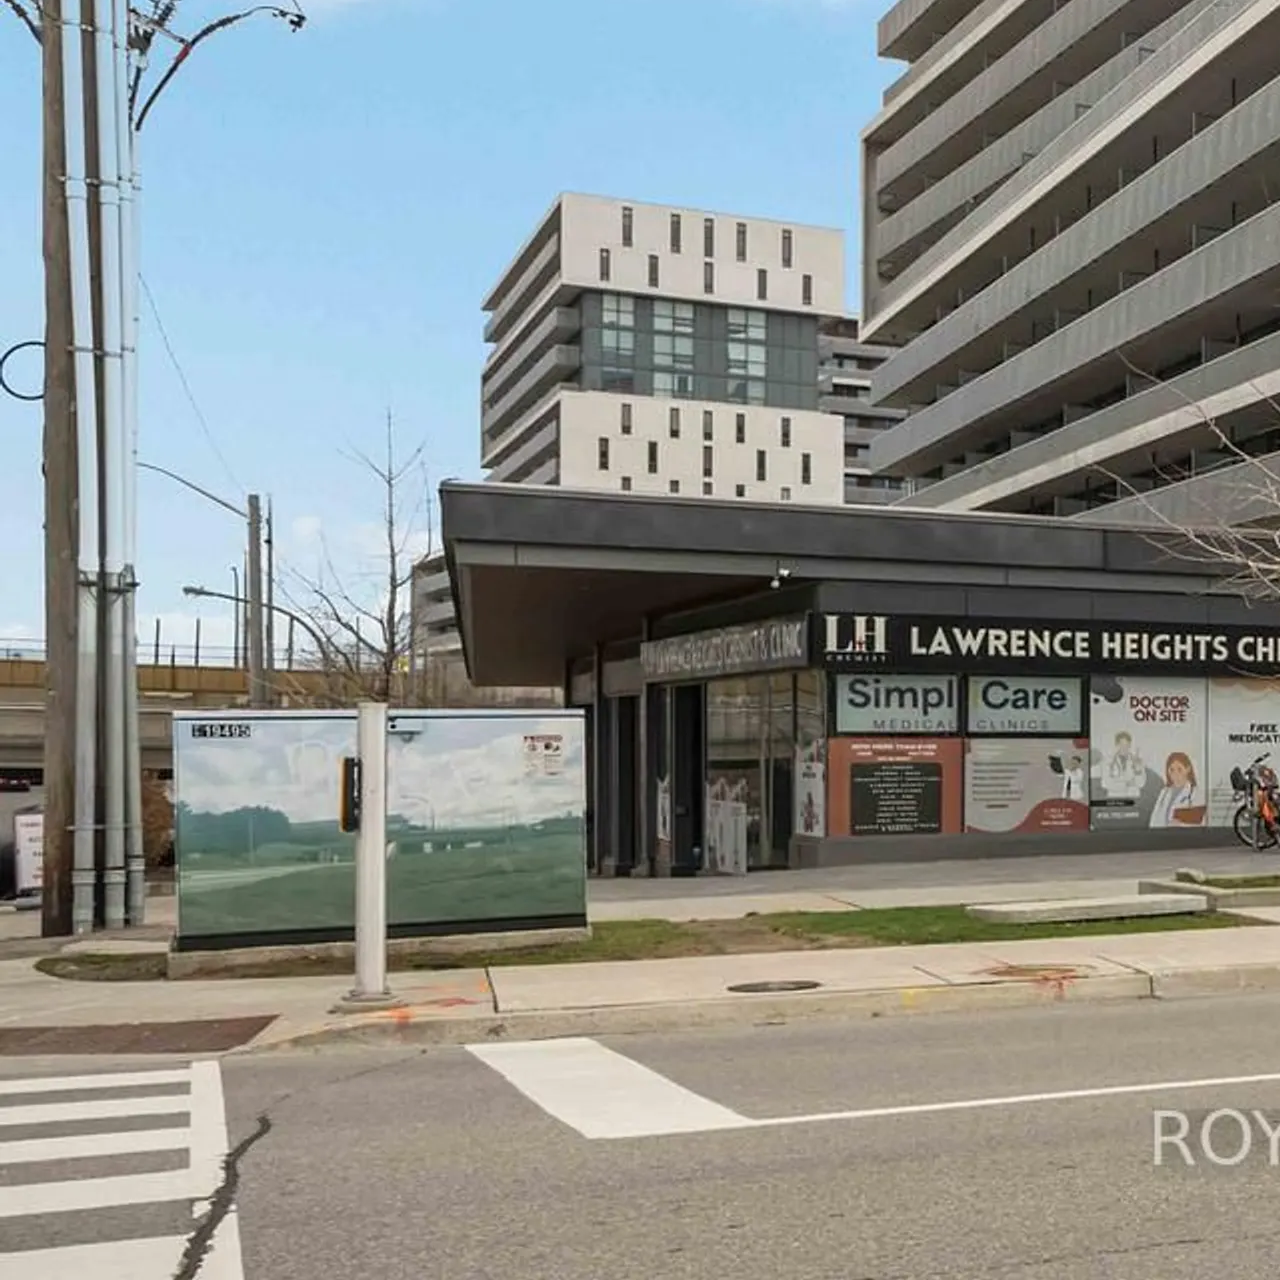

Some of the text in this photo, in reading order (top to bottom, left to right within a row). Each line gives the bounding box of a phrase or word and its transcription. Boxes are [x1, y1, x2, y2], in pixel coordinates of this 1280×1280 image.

[825, 615, 890, 653] LH
[911, 626, 1090, 658] LAWRENCE
[1102, 632, 1228, 661] HEIGHTS
[982, 680, 1067, 710] Care
[1130, 696, 1189, 708] DOCTOR
[1134, 710, 1187, 721] ON SITE
[1250, 724, 1278, 733] FREE
